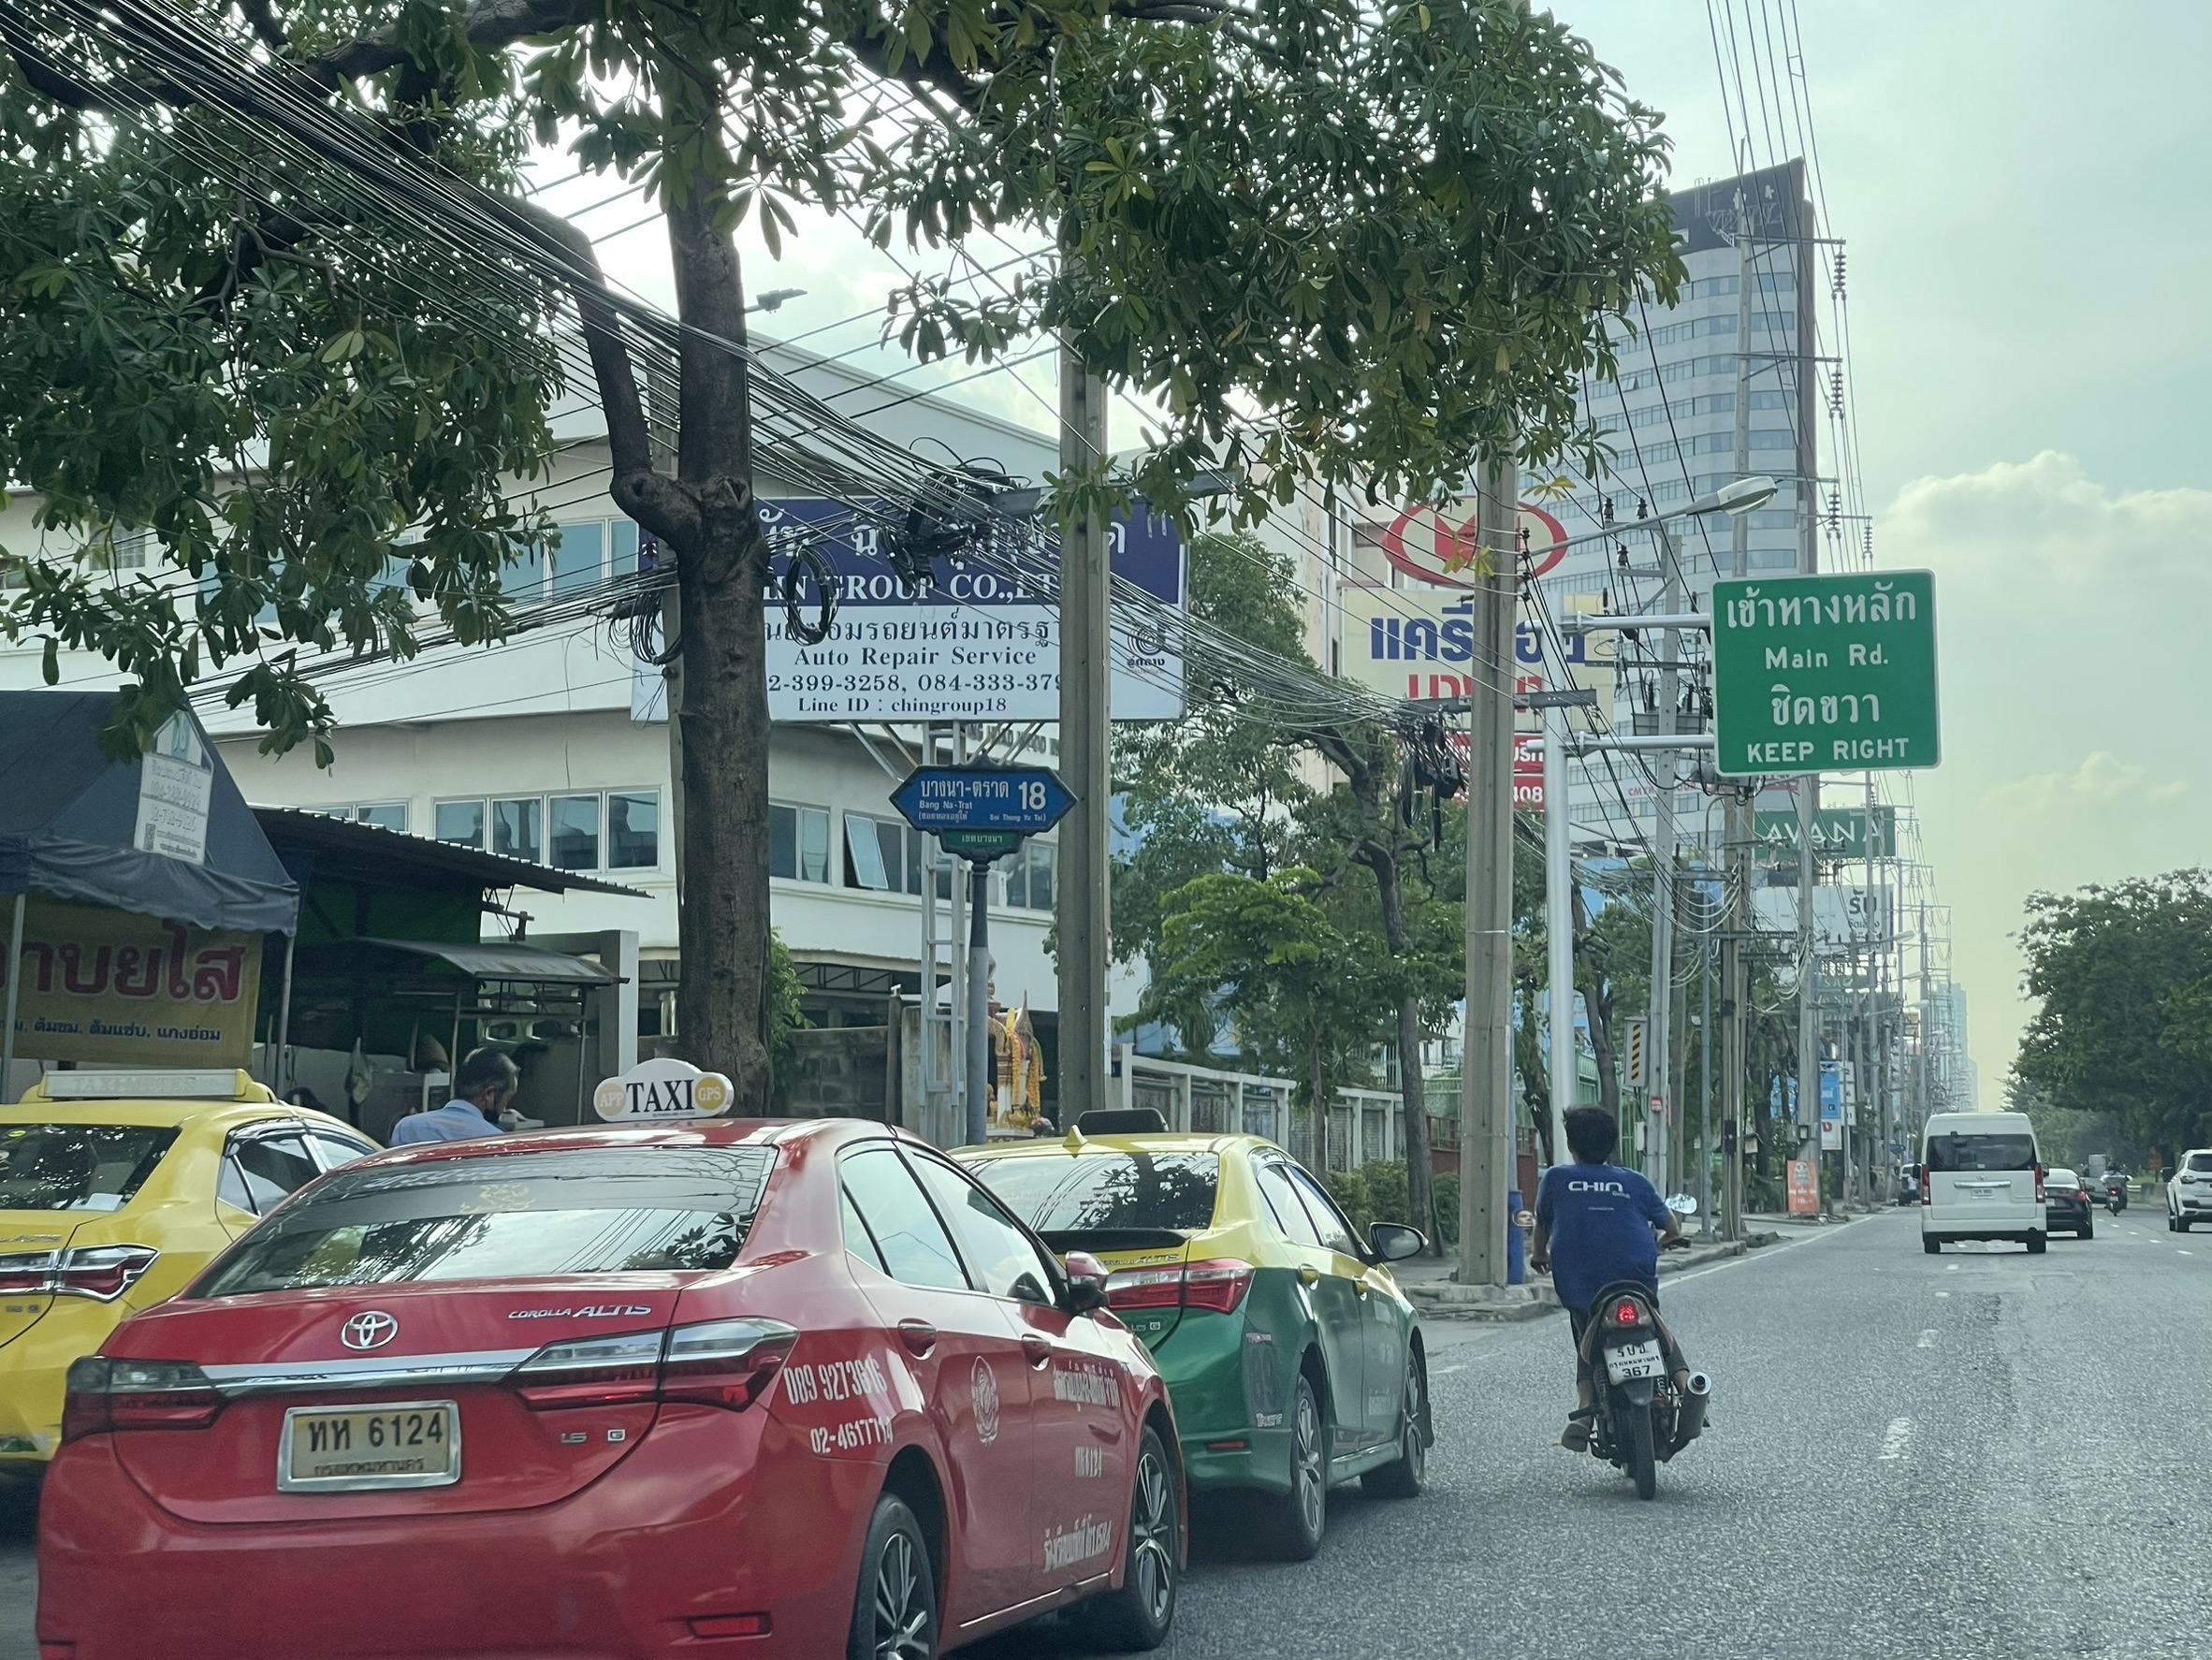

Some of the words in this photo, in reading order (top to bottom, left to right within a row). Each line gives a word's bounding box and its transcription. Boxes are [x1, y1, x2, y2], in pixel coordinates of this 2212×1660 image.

[1726, 581, 1916, 628] เข้าทางหลัก
[794, 648, 850, 665] Auto
[862, 647, 939, 670] Repair
[951, 646, 1037, 665] Service
[1765, 647, 1828, 669] Main
[1850, 643, 1889, 667] Rd.
[767, 674, 908, 696] 2-399-3258,
[798, 697, 838, 712] Line
[848, 698, 869, 712] ID
[891, 697, 1007, 716] chingroup18
[1770, 683, 1881, 726] ชิดขวา
[1747, 740, 1815, 764] KEEP
[1833, 737, 1910, 761] RIGHT
[919, 799, 940, 811] Bang
[921, 780, 1010, 798] บางนา-ตราด
[1018, 780, 1047, 810] 18
[625, 1079, 695, 1114] TAXI
[698, 1086, 722, 1101] GPS
[508, 1308, 572, 1319] COROLLA
[572, 1304, 652, 1318] ALTIS
[1622, 1364, 1651, 1378] 367
[369, 1412, 444, 1449] 6124
